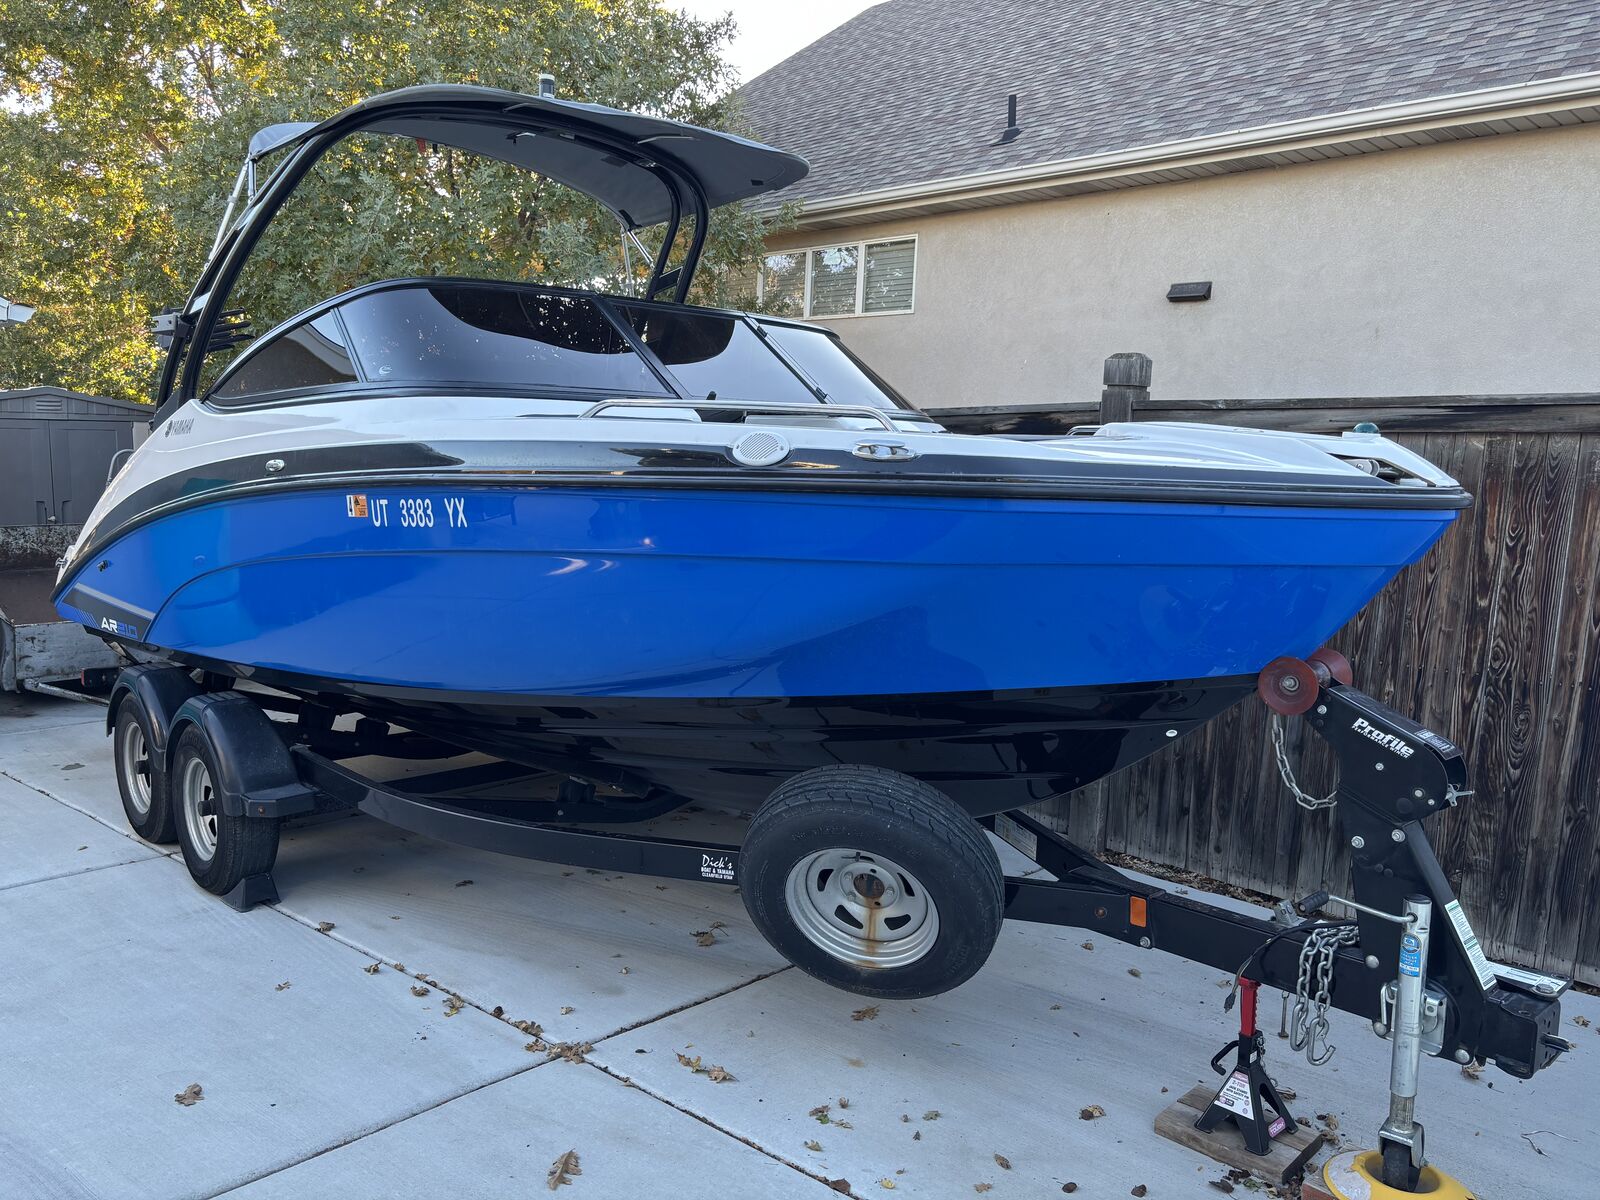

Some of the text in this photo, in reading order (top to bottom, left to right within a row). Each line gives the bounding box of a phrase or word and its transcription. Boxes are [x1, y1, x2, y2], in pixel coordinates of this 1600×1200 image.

[171, 418, 194, 435] YAMAHA
[371, 499, 388, 527] UT
[400, 498, 434, 527] 3383
[444, 498, 468, 527] YX
[1352, 725, 1411, 759] PERFORMANCE WINCH
[1353, 718, 1414, 757] Profile
[702, 854, 733, 869] Dick's
